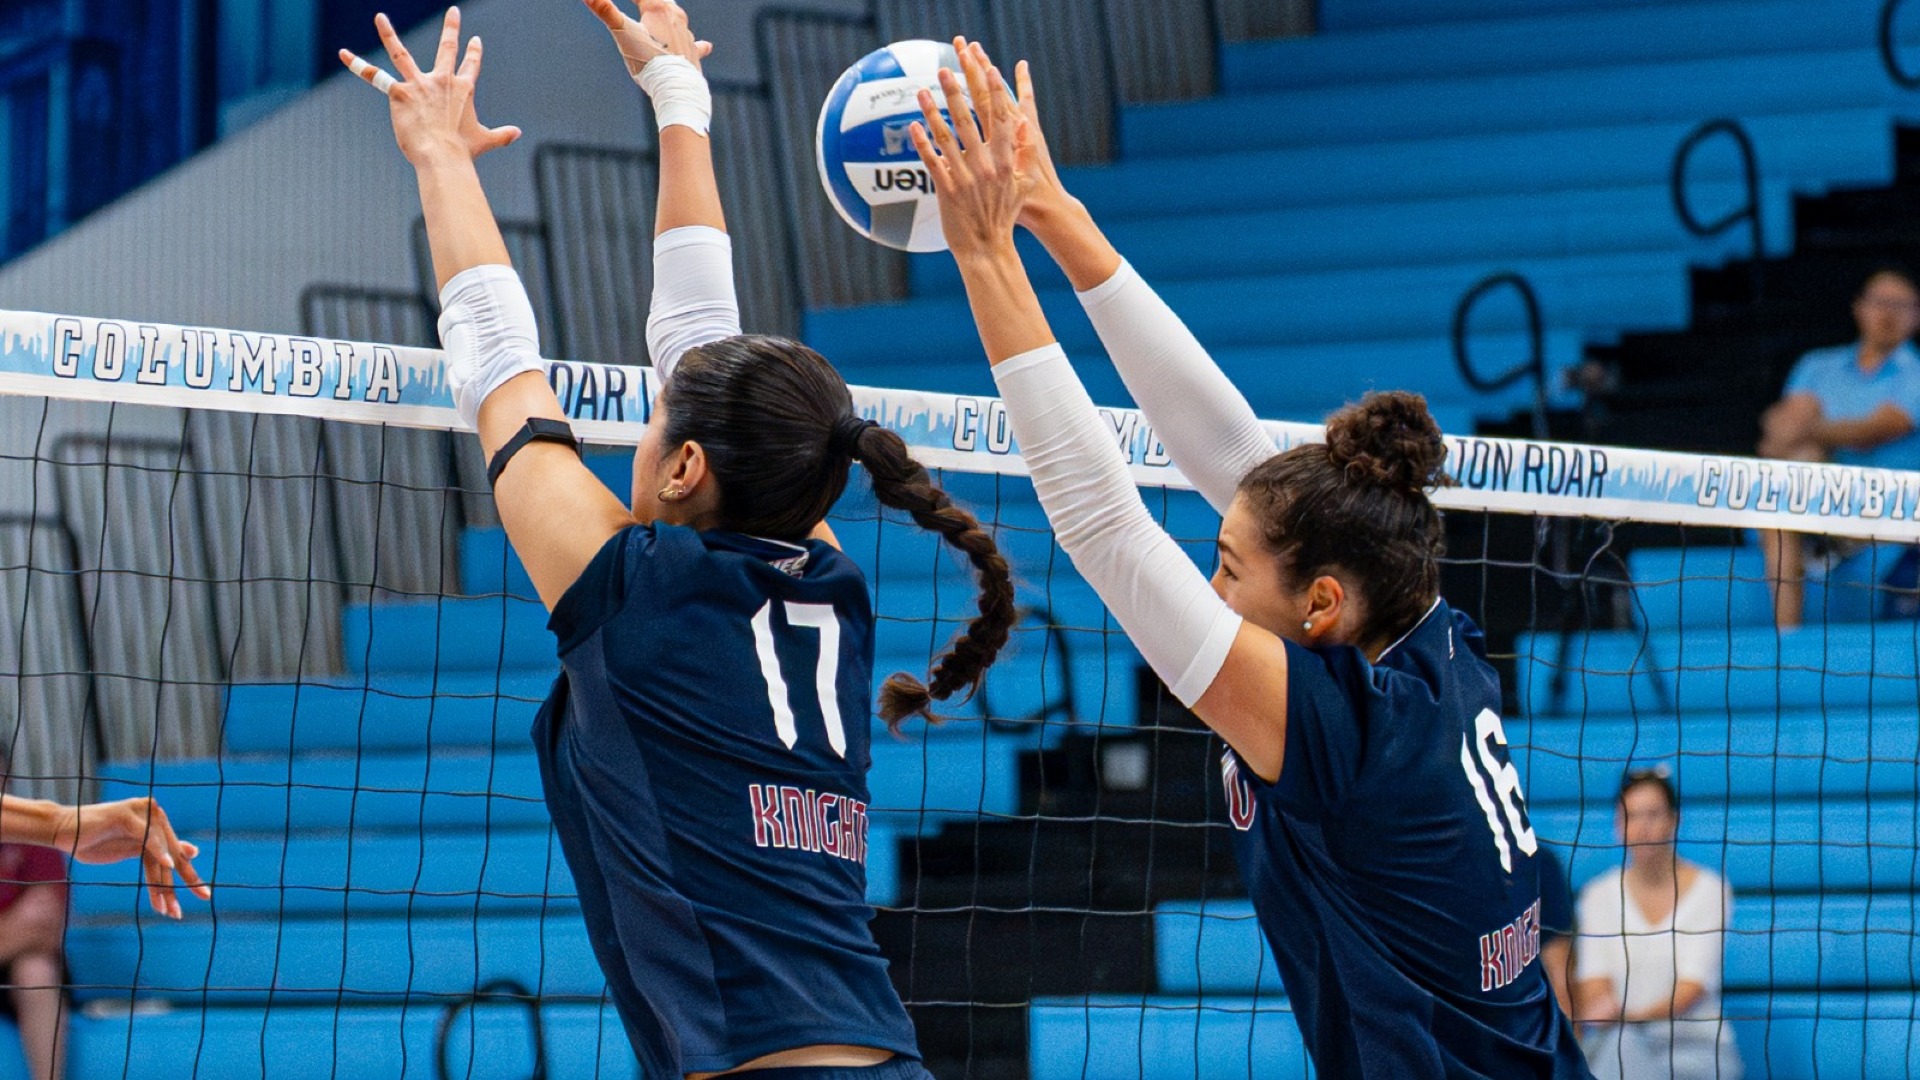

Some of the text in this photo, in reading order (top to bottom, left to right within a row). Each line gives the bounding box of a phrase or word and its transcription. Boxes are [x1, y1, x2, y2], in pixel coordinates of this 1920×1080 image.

[875, 168, 936, 194] ten
[53, 317, 401, 403] COLUMBIA
[549, 361, 625, 423] OAR
[1455, 438, 1608, 499] ION ROAR
[1697, 458, 1920, 521] COLUMBI
[751, 598, 847, 759] 17
[749, 784, 869, 865] KNIGHT
[1461, 707, 1538, 874] 16
[1480, 897, 1541, 992] KNIGH
